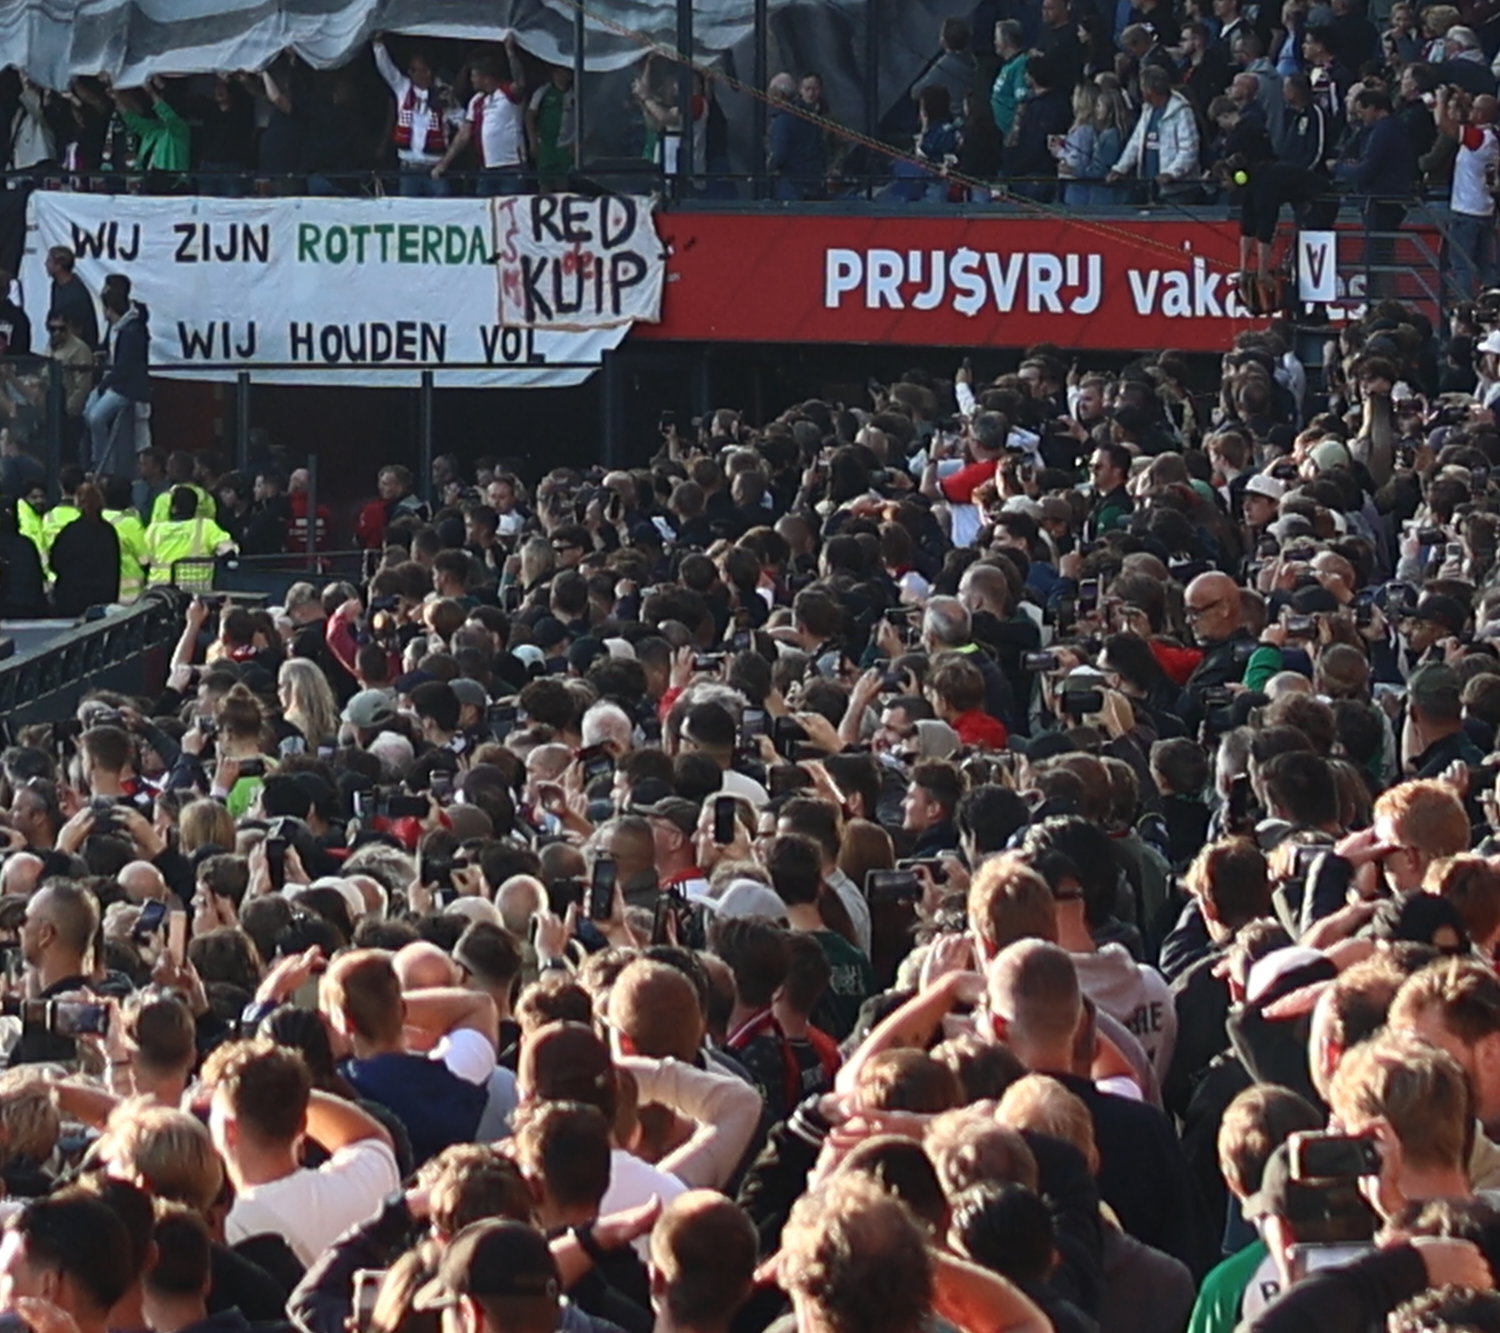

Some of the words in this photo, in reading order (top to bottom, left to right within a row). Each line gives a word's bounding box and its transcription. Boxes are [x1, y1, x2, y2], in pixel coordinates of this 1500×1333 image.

[71, 220, 141, 262] WIJ
[174, 222, 270, 264] ZIJN
[530, 195, 638, 250] RED
[520, 250, 648, 323] KUIP
[178, 320, 257, 360] WIJ
[289, 320, 447, 363] HOUDEN
[479, 324, 546, 363] VOL
